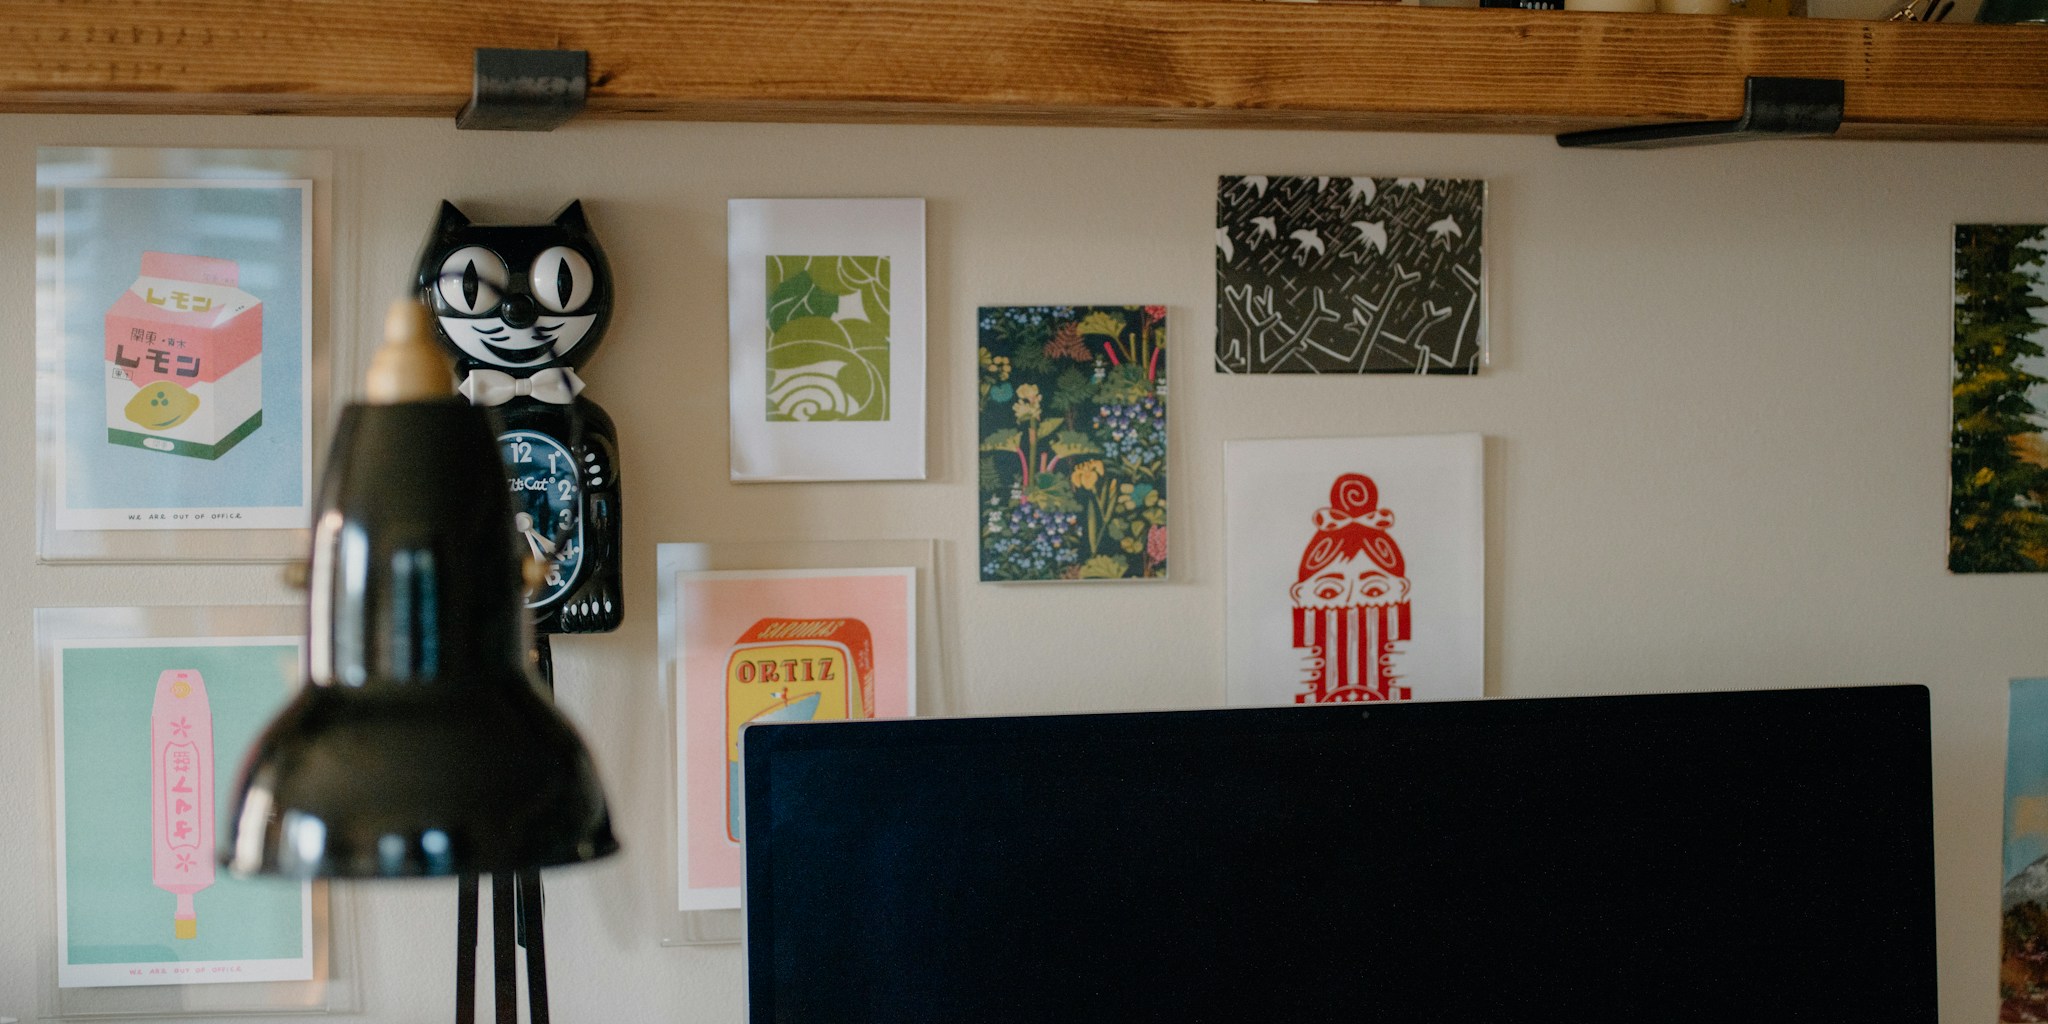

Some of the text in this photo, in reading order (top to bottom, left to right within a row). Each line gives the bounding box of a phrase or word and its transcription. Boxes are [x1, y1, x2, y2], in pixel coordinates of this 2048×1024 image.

[146, 287, 212, 313] レモン
[114, 344, 200, 378] レモン
[510, 441, 533, 463] 12
[548, 453, 557, 475] 1
[557, 479, 572, 501] 2
[211, 512, 242, 520] OFFICE
[558, 508, 573, 531] 3
[562, 538, 575, 560] 4
[736, 657, 836, 684] ORTIZ
